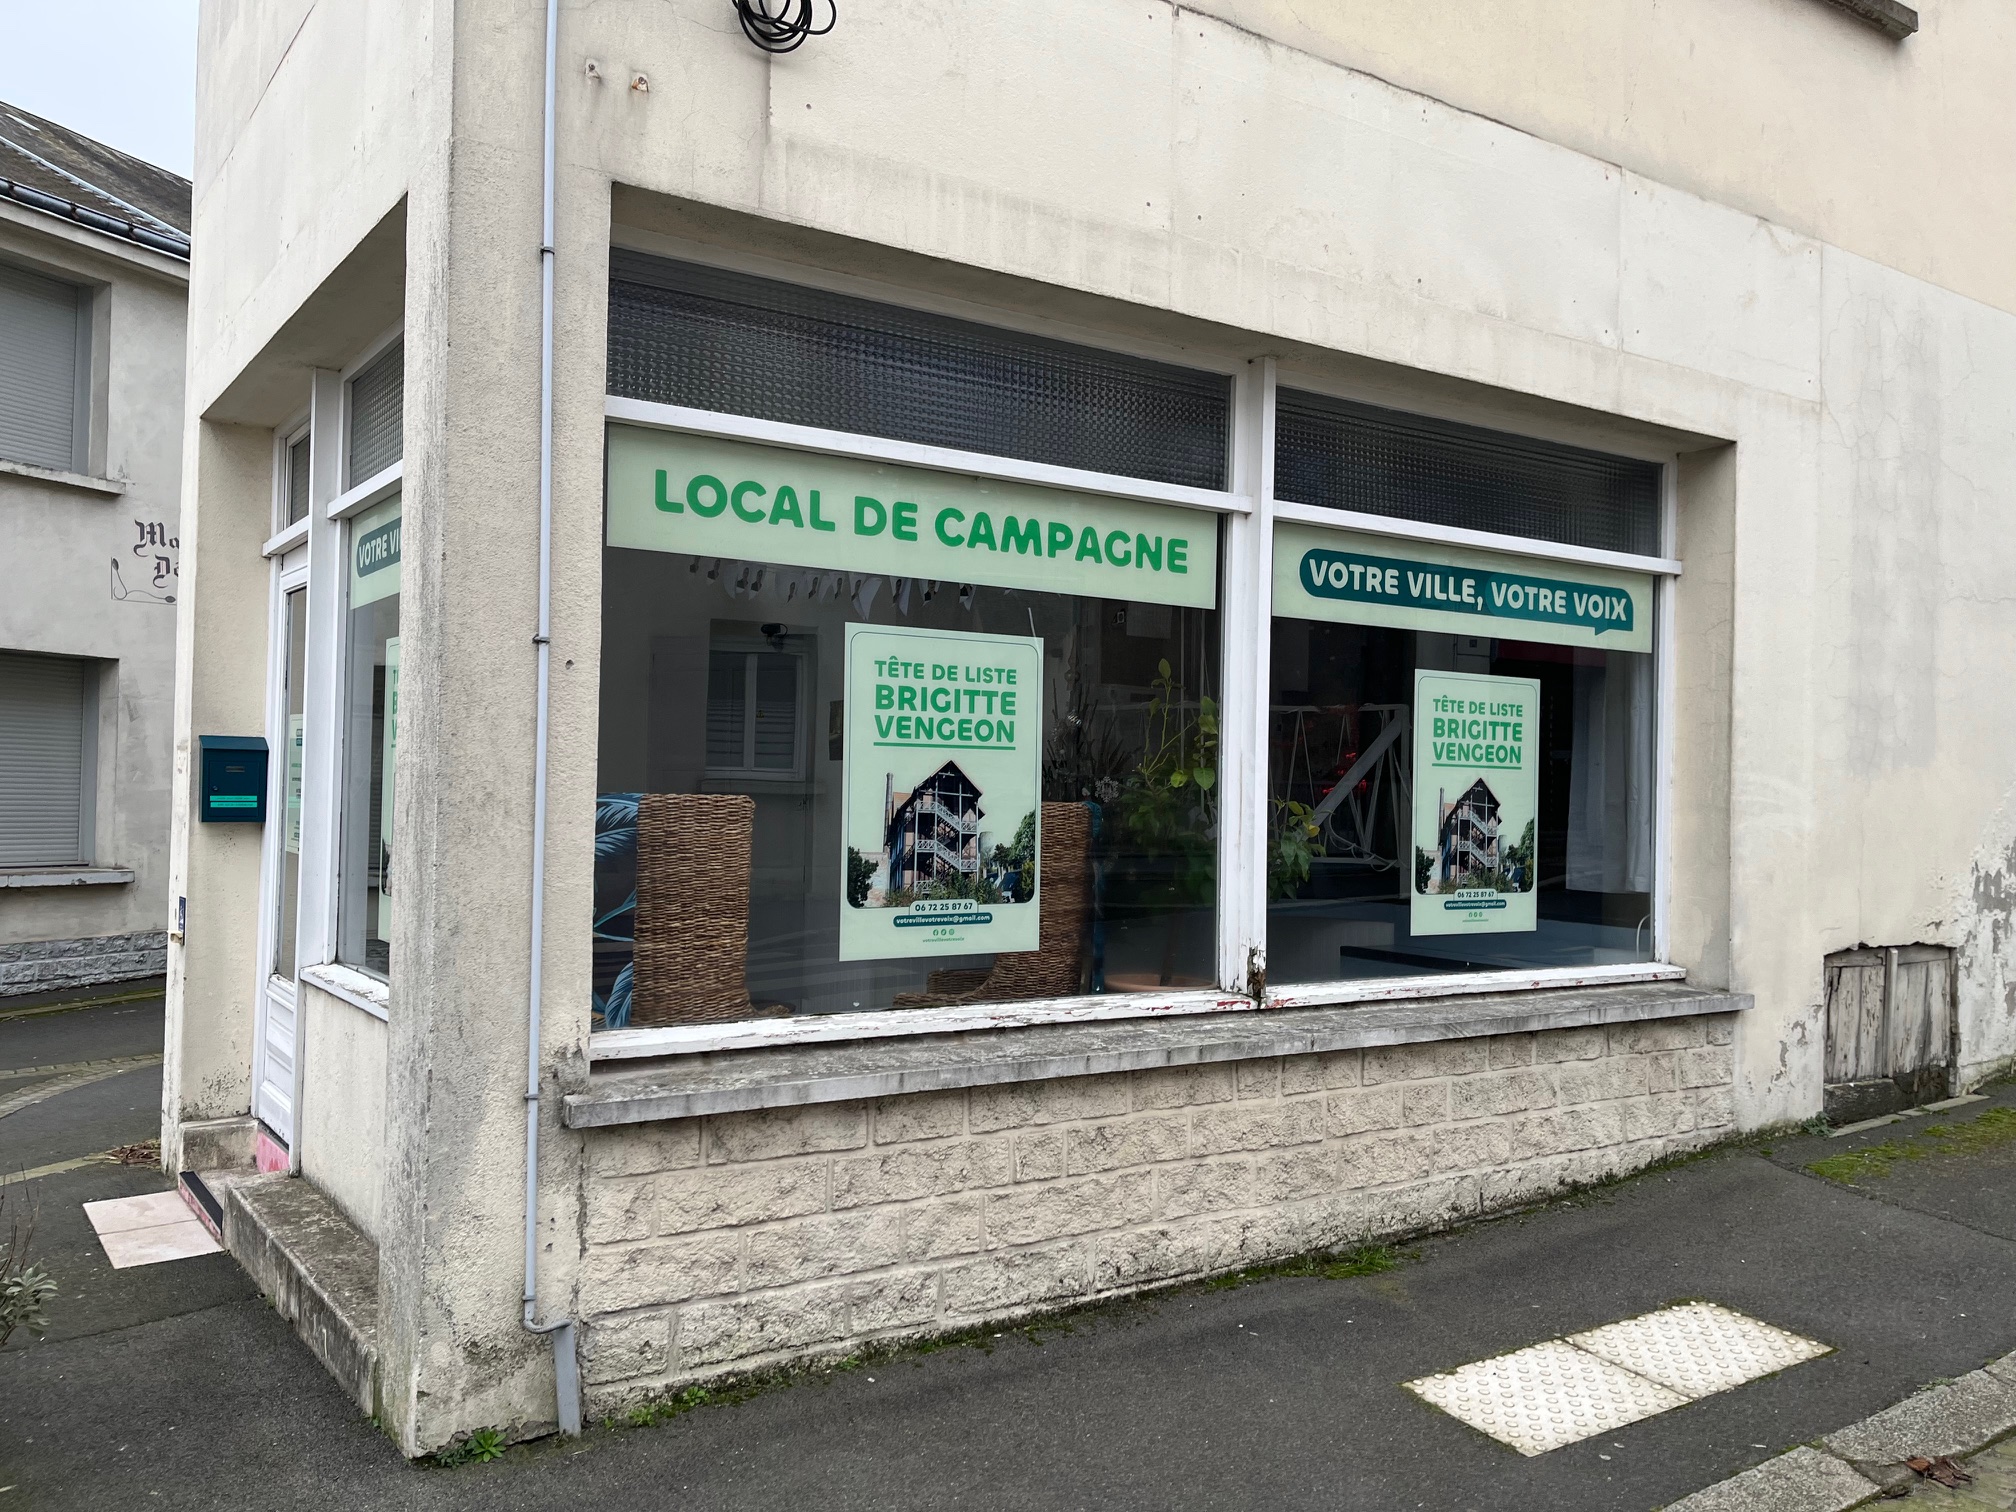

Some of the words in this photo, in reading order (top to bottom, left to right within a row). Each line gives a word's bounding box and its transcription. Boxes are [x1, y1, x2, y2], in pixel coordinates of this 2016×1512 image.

[654, 469, 836, 531] LOCAL
[854, 495, 918, 542] DE
[934, 507, 1188, 574] CAMPAGNE
[359, 533, 387, 568] VOTRE
[1308, 558, 1400, 595] VOTRE
[1406, 570, 1484, 611] VILLE,
[1490, 581, 1567, 614] VOTRE
[1573, 592, 1627, 621] VOIX
[874, 655, 925, 679] TÊTE
[932, 664, 958, 681] DE
[965, 666, 1017, 685] LISTE
[875, 684, 1016, 716] BRIGITTE
[1432, 694, 1465, 713] TÊTE
[1469, 701, 1485, 715] DE
[1490, 702, 1523, 717] LISTE
[874, 715, 1015, 743] VENGEON
[1433, 717, 1523, 742] BRIGITTE
[1432, 741, 1522, 764] VENGEON
[914, 903, 926, 912] 06
[928, 903, 938, 911] 72
[940, 902, 950, 911] 25
[951, 902, 962, 911] 87
[963, 902, 973, 910] 67
